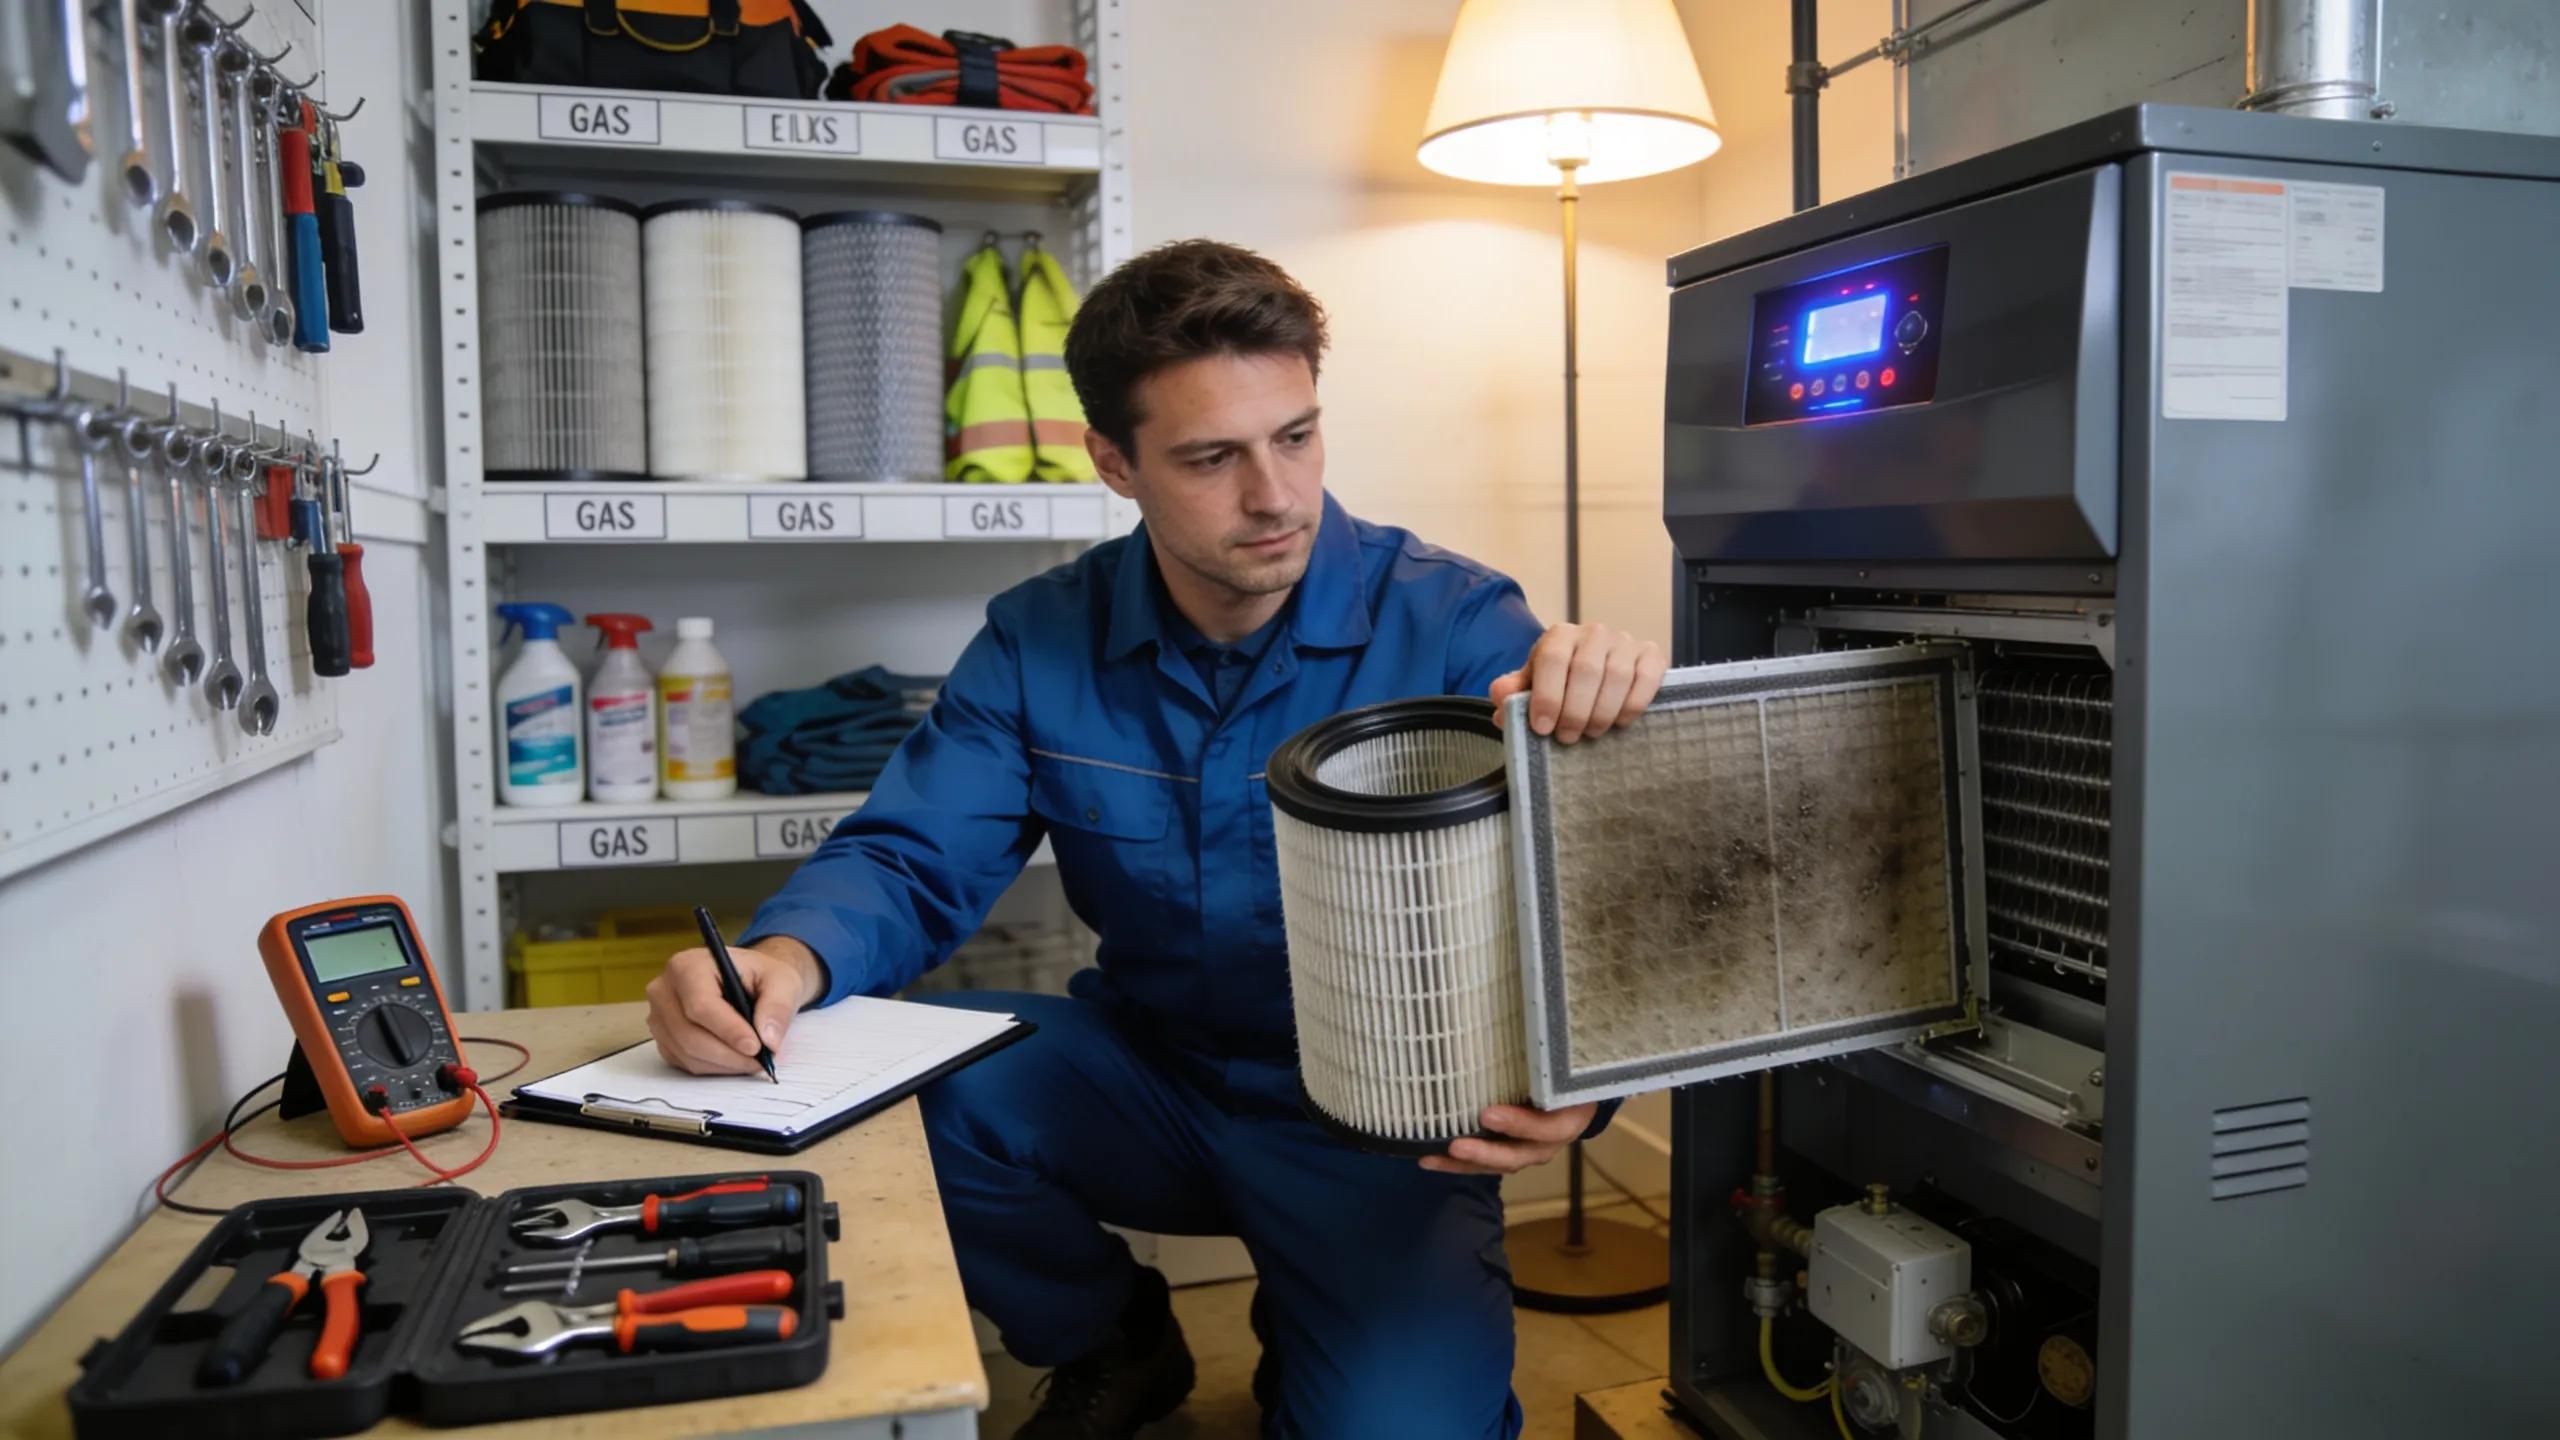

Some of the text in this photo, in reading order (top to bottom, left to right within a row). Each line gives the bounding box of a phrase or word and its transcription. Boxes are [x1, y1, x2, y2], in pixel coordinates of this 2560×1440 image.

[568, 103, 631, 136] GAS
[962, 123, 1018, 155] GAS
[576, 500, 636, 532] GAS
[777, 501, 835, 532] GAS
[971, 501, 1024, 531] GAS
[589, 825, 650, 859] GAS
